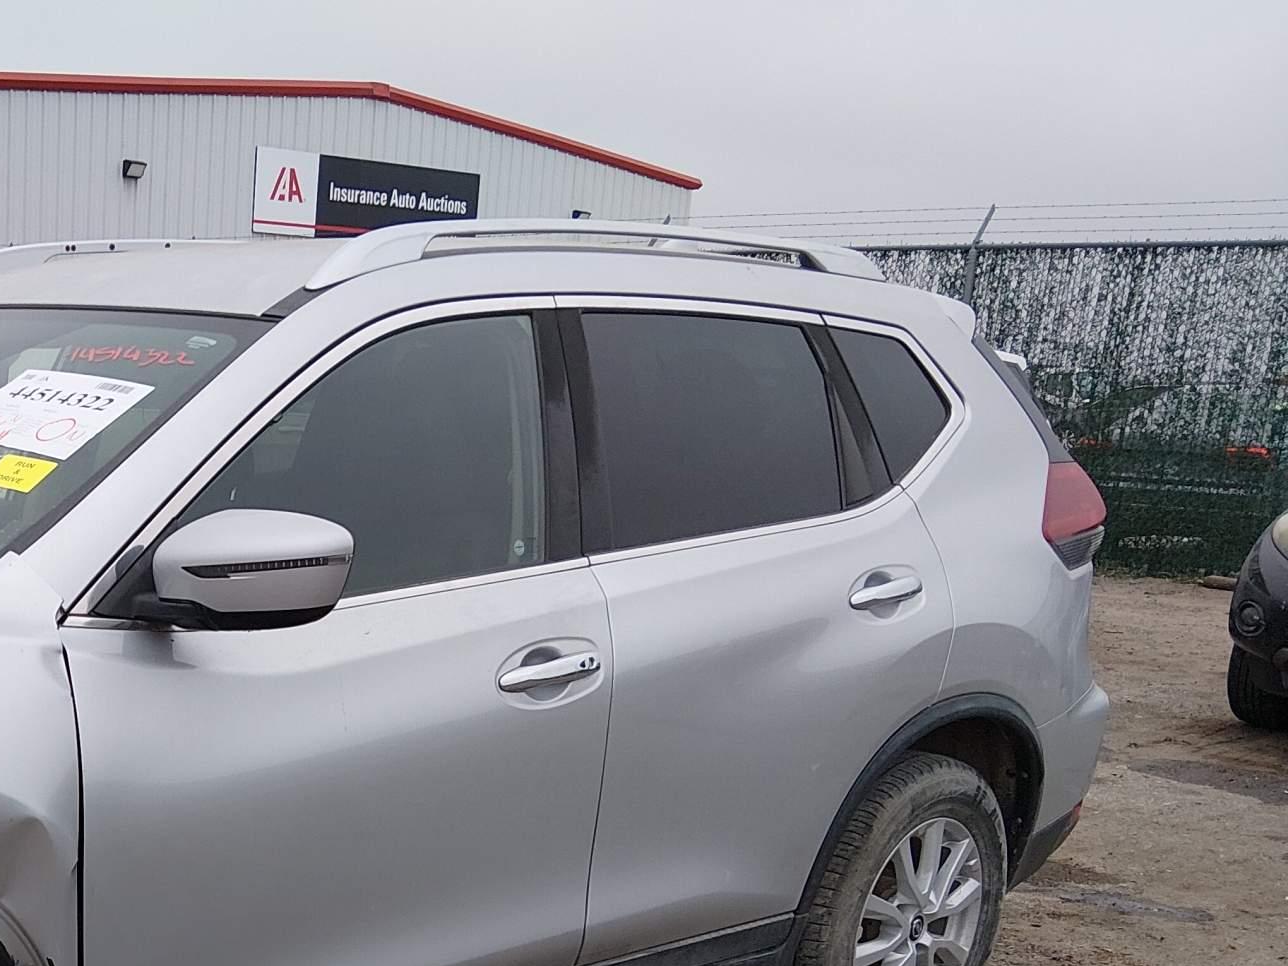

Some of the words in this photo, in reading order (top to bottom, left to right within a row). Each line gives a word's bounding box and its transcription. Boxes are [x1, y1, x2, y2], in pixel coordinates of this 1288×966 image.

[329, 182, 388, 207] Insurance
[390, 189, 416, 210] Auto
[418, 191, 468, 216] Auctions
[9, 385, 116, 412] 44514322
